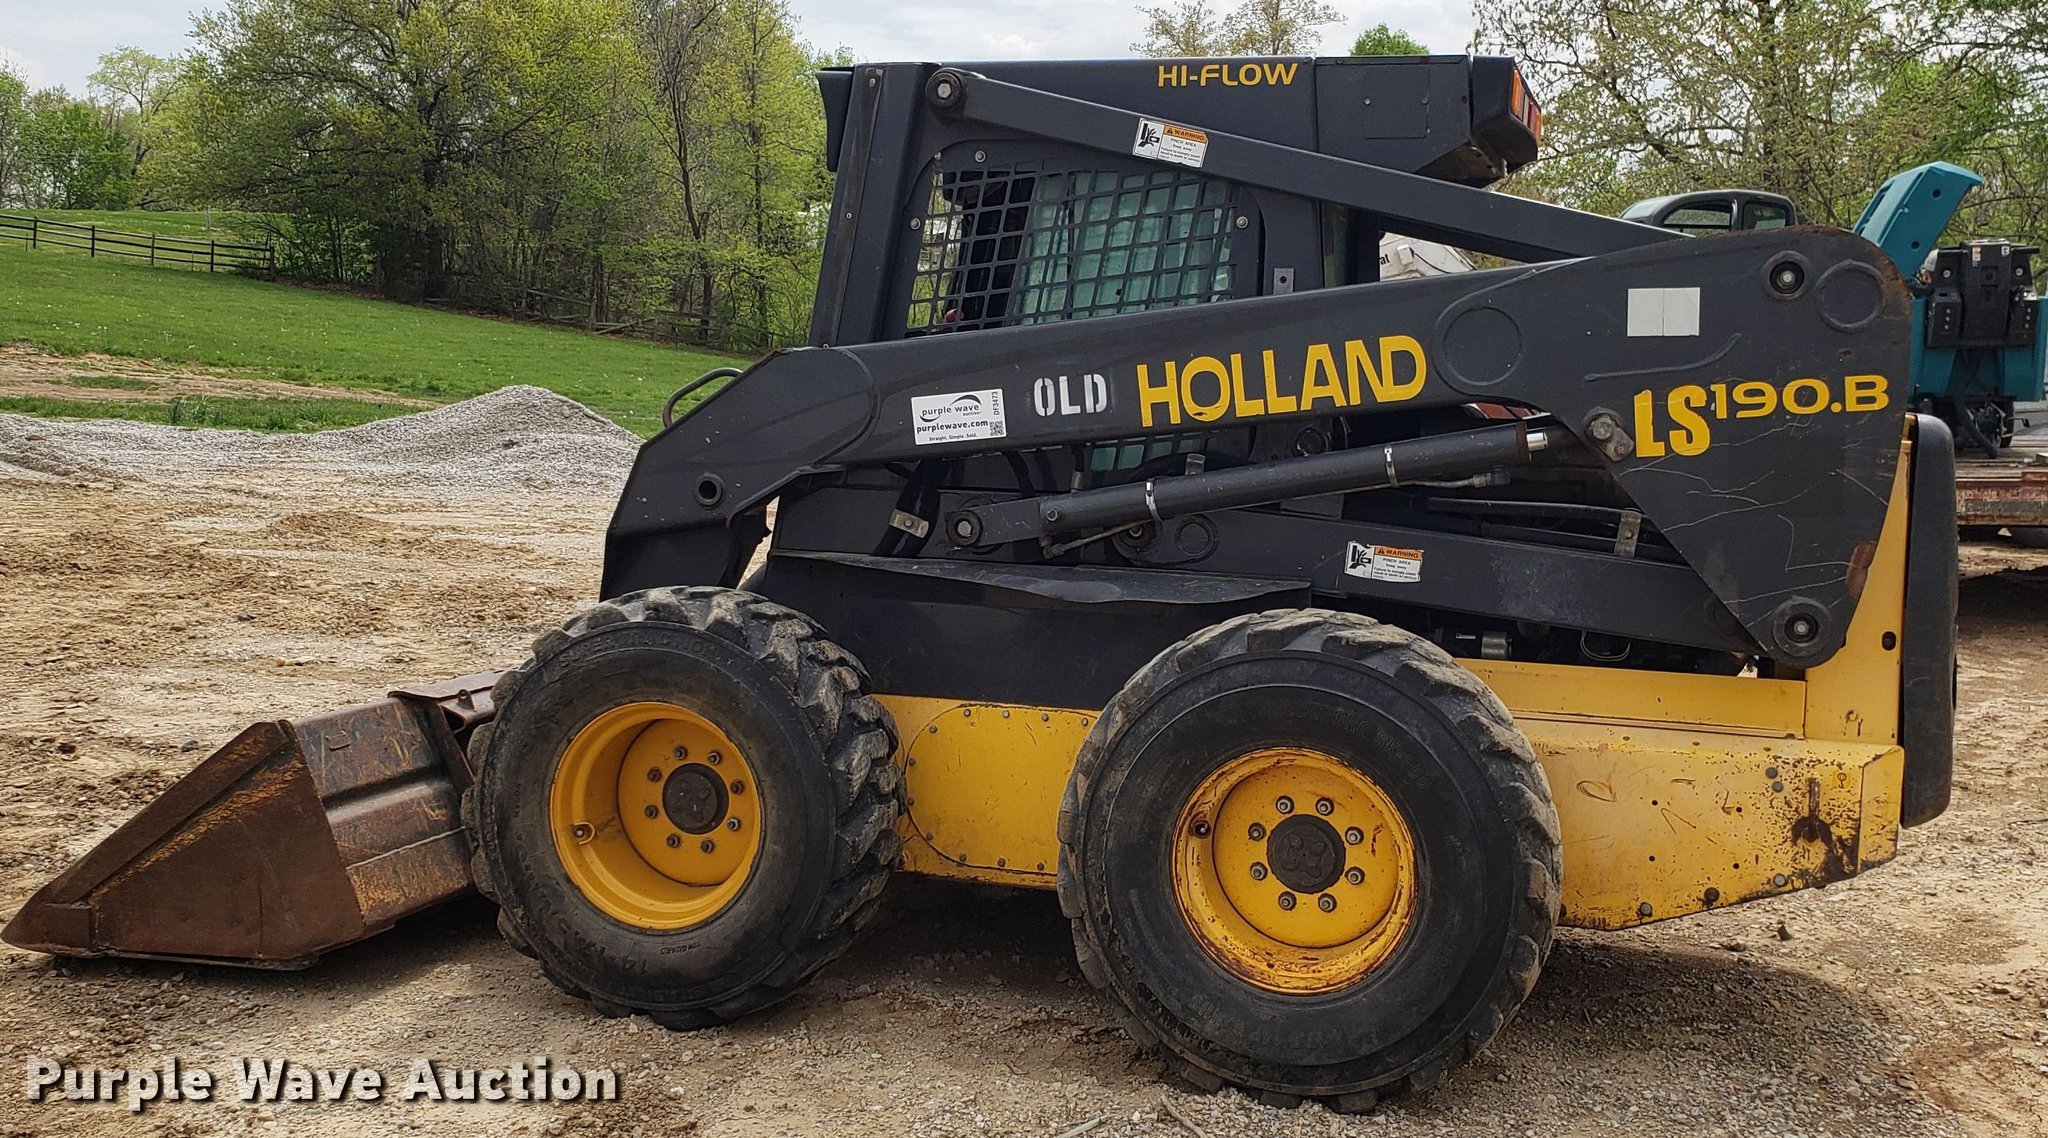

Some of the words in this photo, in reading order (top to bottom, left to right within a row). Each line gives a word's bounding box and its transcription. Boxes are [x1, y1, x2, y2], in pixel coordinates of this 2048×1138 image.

[1157, 62, 1299, 87] HI-FLOW
[1174, 129, 1205, 141] WARNING
[1033, 373, 1108, 417] OLD
[1136, 334, 1427, 428] HOLLAND
[991, 391, 1000, 416] DF3473
[921, 406, 952, 417] purple
[954, 404, 980, 412] wave
[916, 420, 989, 434] purplewave.com
[1386, 549, 1418, 558] WARNING
[660, 944, 688, 955] GUARD
